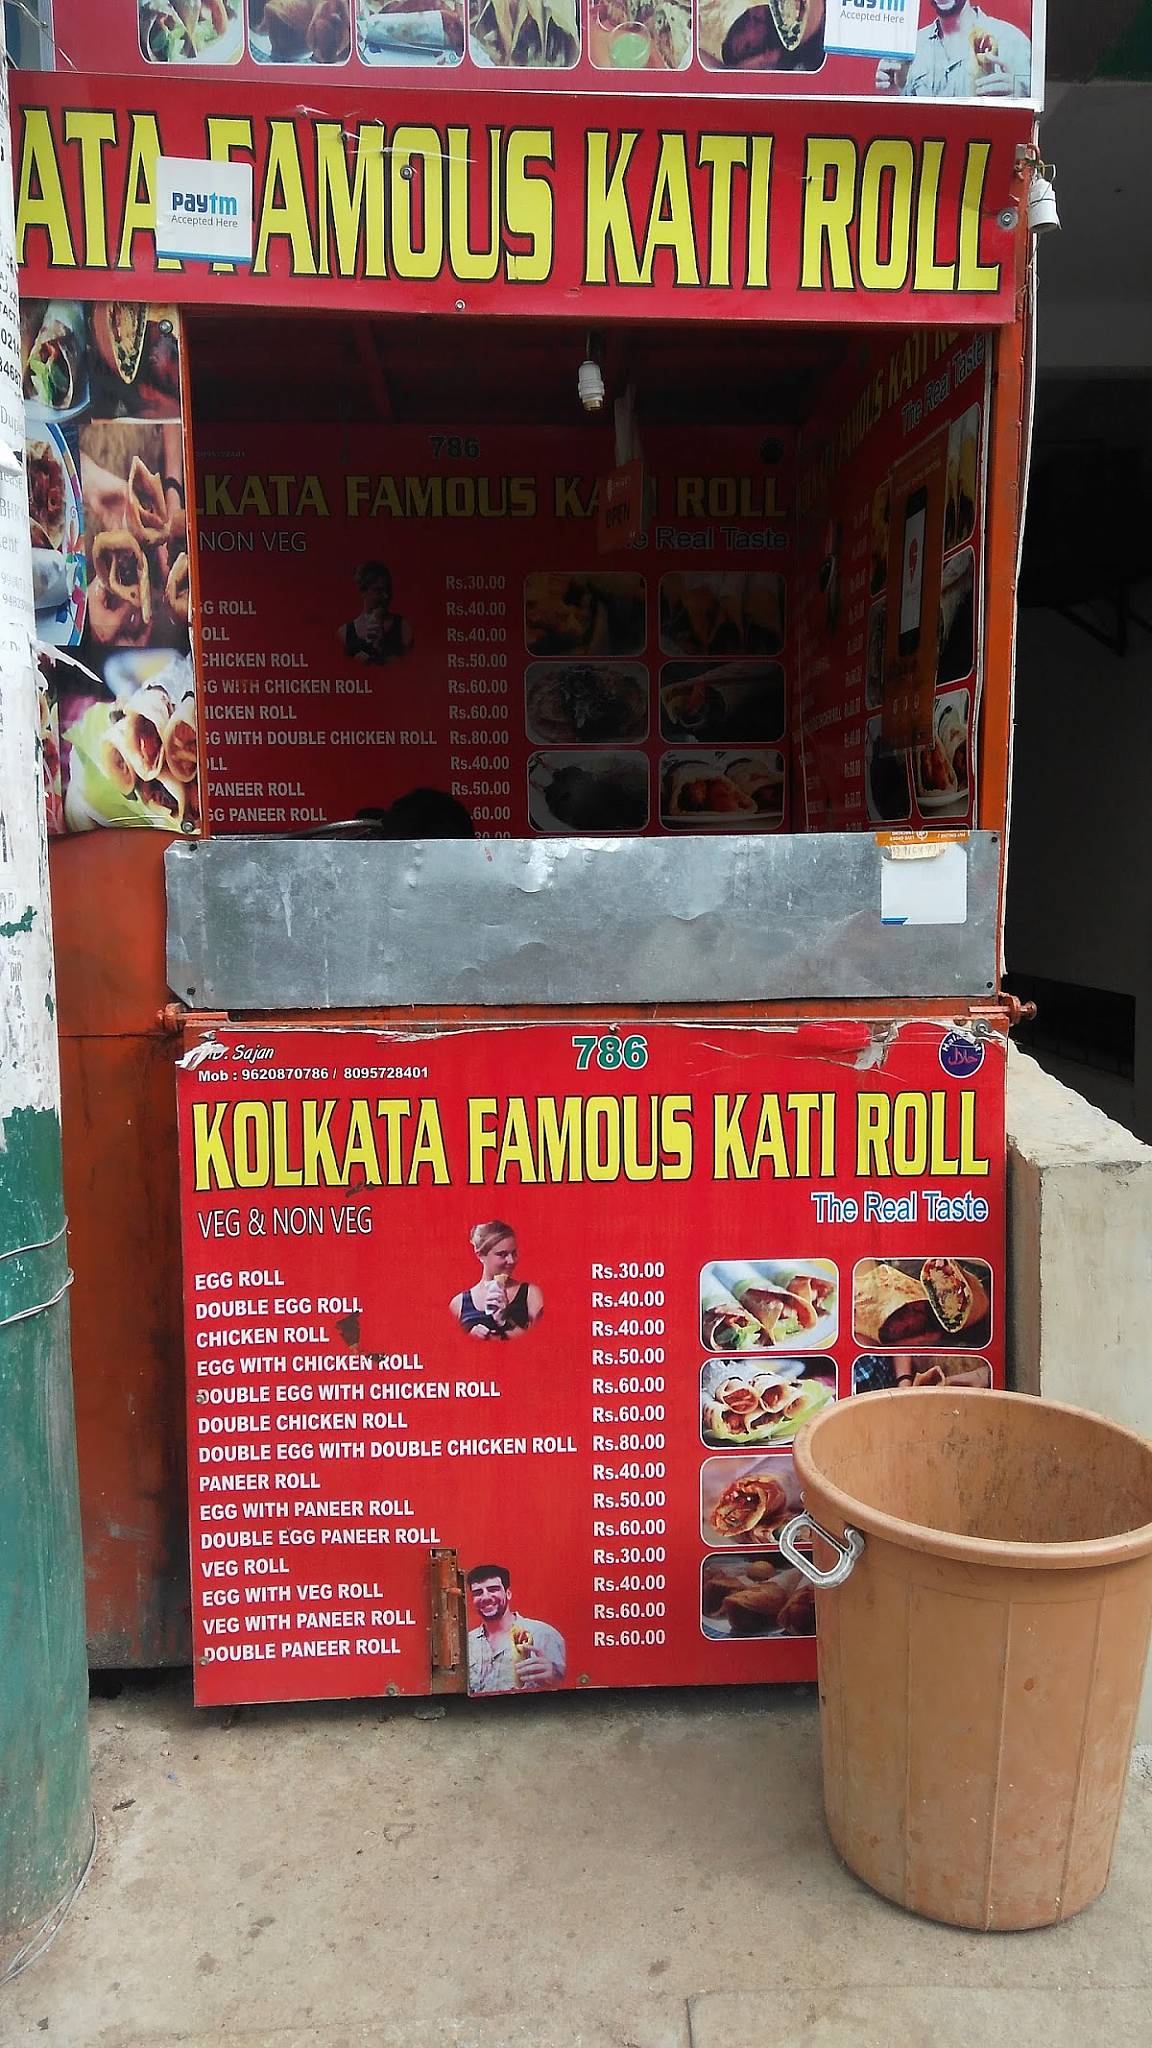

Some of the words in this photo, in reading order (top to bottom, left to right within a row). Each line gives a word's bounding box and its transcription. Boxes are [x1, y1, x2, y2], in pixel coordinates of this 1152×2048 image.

[840, 10, 880, 22] Accepted
[884, 14, 904, 23] Here
[581, 129, 774, 289] KATI
[798, 133, 1006, 295] ROLL
[171, 214, 213, 227] Accepted
[215, 218, 238, 228] Here
[430, 436, 480, 459] 786
[196, 473, 331, 517] KATA
[345, 473, 536, 518] FAMOUS
[676, 476, 787, 517] ROLL
[199, 531, 255, 552] NON
[262, 531, 307, 552] VEG
[655, 526, 714, 551] Real
[720, 526, 789, 551] Taste
[446, 575, 506, 590] Rs.30.00
[219, 600, 256, 615] ROLL
[446, 601, 506, 616] Rs.40.00
[447, 628, 507, 642] Rs.40.00
[201, 653, 266, 668] CHICKEN
[271, 653, 308, 667] ROLL
[447, 653, 507, 668] Rs.50.00
[222, 679, 260, 693] WITH
[264, 679, 330, 693] CHICKEN
[335, 680, 372, 693] ROLL
[448, 680, 508, 694] Rs.60.00
[260, 706, 297, 720] ROLL
[449, 705, 509, 720] Rs.60.00
[225, 731, 263, 745] WITH
[267, 731, 326, 745] DOUBLE
[330, 731, 396, 745] CHICKEN
[400, 731, 437, 745] ROLL
[449, 731, 509, 745] Rs.80.00
[450, 756, 510, 770] Rs.40.00
[208, 782, 263, 796] PANEER
[268, 783, 305, 796] ROLL
[451, 781, 510, 796] Rs.50.00
[229, 807, 286, 822] PANEER
[290, 808, 327, 821] ROLL
[232, 1044, 275, 1064] Sajan
[571, 1035, 649, 1071] 786
[198, 1070, 229, 1082] Mob
[241, 1067, 329, 1081] 9620870786
[343, 1066, 429, 1080] 8095728401
[192, 1097, 451, 1191] KOLKATA
[467, 1092, 694, 1184] FAMOUS
[713, 1091, 836, 1180] KATI
[856, 1090, 990, 1177] ROLL
[811, 1192, 858, 1224] The
[863, 1190, 917, 1222] Real
[923, 1189, 990, 1221] Taste
[197, 1209, 240, 1239] VEG
[248, 1208, 266, 1236] &
[273, 1206, 324, 1235] NON
[330, 1206, 373, 1234] VEG
[591, 1262, 665, 1279] Rs.30.00
[195, 1272, 232, 1290] EGG
[238, 1270, 284, 1287] ROLL
[592, 1291, 665, 1307] Rs.40.00
[195, 1300, 268, 1320] DOUBLE
[274, 1298, 312, 1315] EGG
[317, 1297, 363, 1313] ROLL
[592, 1319, 665, 1336] Rs.40.00
[196, 1329, 278, 1348] CHICKEN
[283, 1327, 330, 1344] ROLL
[197, 1359, 234, 1376] EGG
[240, 1357, 286, 1374] WITH
[292, 1355, 373, 1373] CHICKEN
[378, 1354, 423, 1371] ROLL
[592, 1348, 665, 1365] Rs.50.00
[198, 1387, 270, 1404] DOUBLE
[275, 1385, 313, 1402] EGG
[318, 1384, 364, 1400] WITH
[370, 1382, 449, 1399] CHICKEN
[455, 1381, 500, 1398] ROLL
[592, 1377, 665, 1394] Rs.60.00
[592, 1405, 665, 1422] Rs.60.00
[198, 1414, 271, 1434] DOUBLE
[276, 1413, 357, 1431] CHICKEN
[362, 1412, 407, 1429] ROLL
[198, 1443, 271, 1462] DOUBLE
[276, 1442, 314, 1460] EGG
[319, 1441, 364, 1459] WITH
[371, 1439, 442, 1458] DOUBLE
[447, 1438, 527, 1455] CHICKEN
[532, 1436, 577, 1453] ROLL
[592, 1434, 665, 1451] Rs.80.00
[592, 1463, 665, 1480] Rs.40.00
[199, 1474, 270, 1492] PANEER
[274, 1473, 320, 1490] ROLL
[593, 1491, 665, 1508] Rs.50.00
[200, 1504, 237, 1521] EGG
[242, 1502, 289, 1519] WITH
[294, 1501, 363, 1518] PANEER
[369, 1499, 414, 1516] ROLL
[593, 1519, 665, 1536] Rs.60.00
[200, 1531, 273, 1550] DOUBLE
[278, 1530, 315, 1546] EGG
[321, 1528, 390, 1545] PANEER
[395, 1527, 440, 1544] ROLL
[593, 1547, 665, 1564] Rs.30.00
[201, 1560, 238, 1578] VEG
[244, 1558, 289, 1575] ROLL
[594, 1575, 665, 1592] Rs.40.00
[202, 1589, 240, 1607] EGG
[245, 1587, 291, 1604] WITH
[296, 1584, 333, 1601] VEG
[338, 1583, 383, 1599] ROLL
[594, 1602, 665, 1619] Rs.60.00
[203, 1617, 240, 1635] VEG
[245, 1615, 291, 1632] WITH
[296, 1612, 366, 1630] PANEER
[371, 1610, 416, 1627] ROLL
[594, 1629, 665, 1646] Rs.60.00
[204, 1643, 276, 1663] DOUBLE
[281, 1641, 351, 1659] PANEER
[356, 1638, 400, 1656] ROLL
